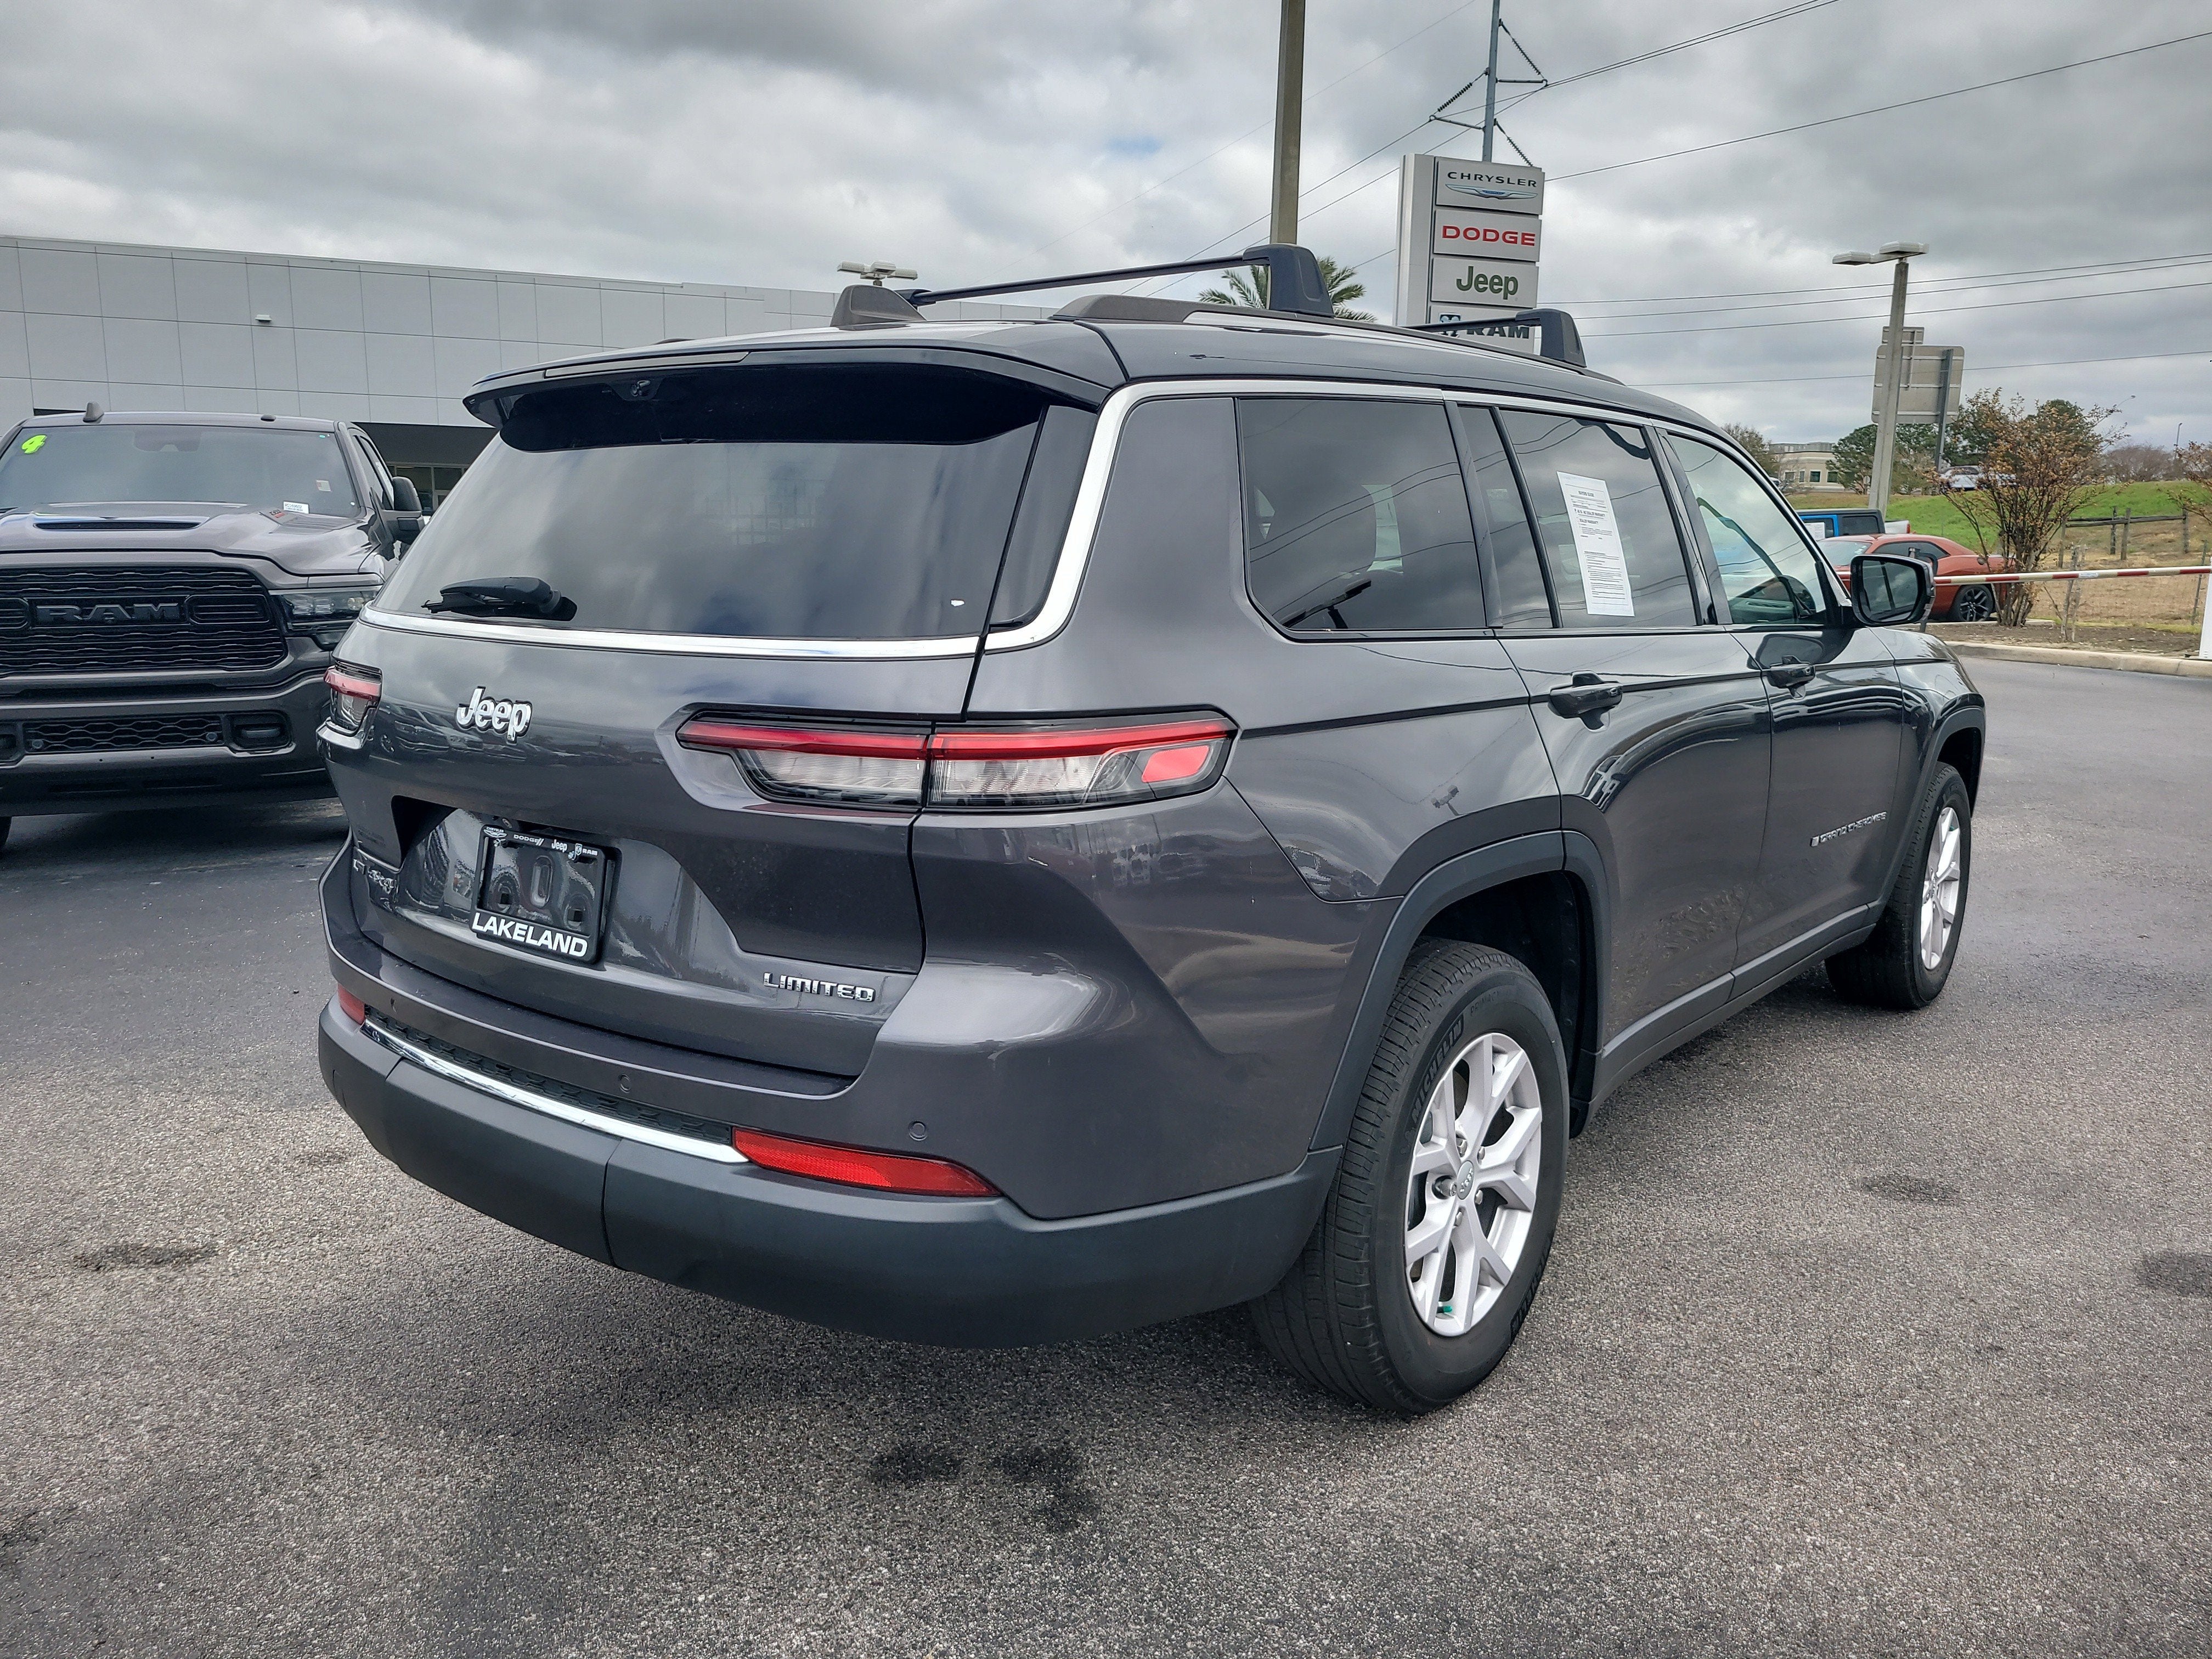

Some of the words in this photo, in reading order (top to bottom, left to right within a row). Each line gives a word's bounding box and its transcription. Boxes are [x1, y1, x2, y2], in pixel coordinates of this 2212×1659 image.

[1447, 171, 1537, 188] CHRYSLER
[1442, 225, 1536, 246] DODGE
[1456, 266, 1519, 300] Jeep
[22, 435, 47, 454] 4
[36, 603, 178, 622] RAM
[456, 686, 532, 743] Jeep
[514, 834, 539, 843] DODGE
[1820, 826, 1847, 843] GRAND
[551, 839, 567, 853] Jeep
[472, 912, 588, 957] LAKELAND
[763, 972, 876, 1002] LIMITED
[1411, 1019, 1462, 1124] MICHELIN
